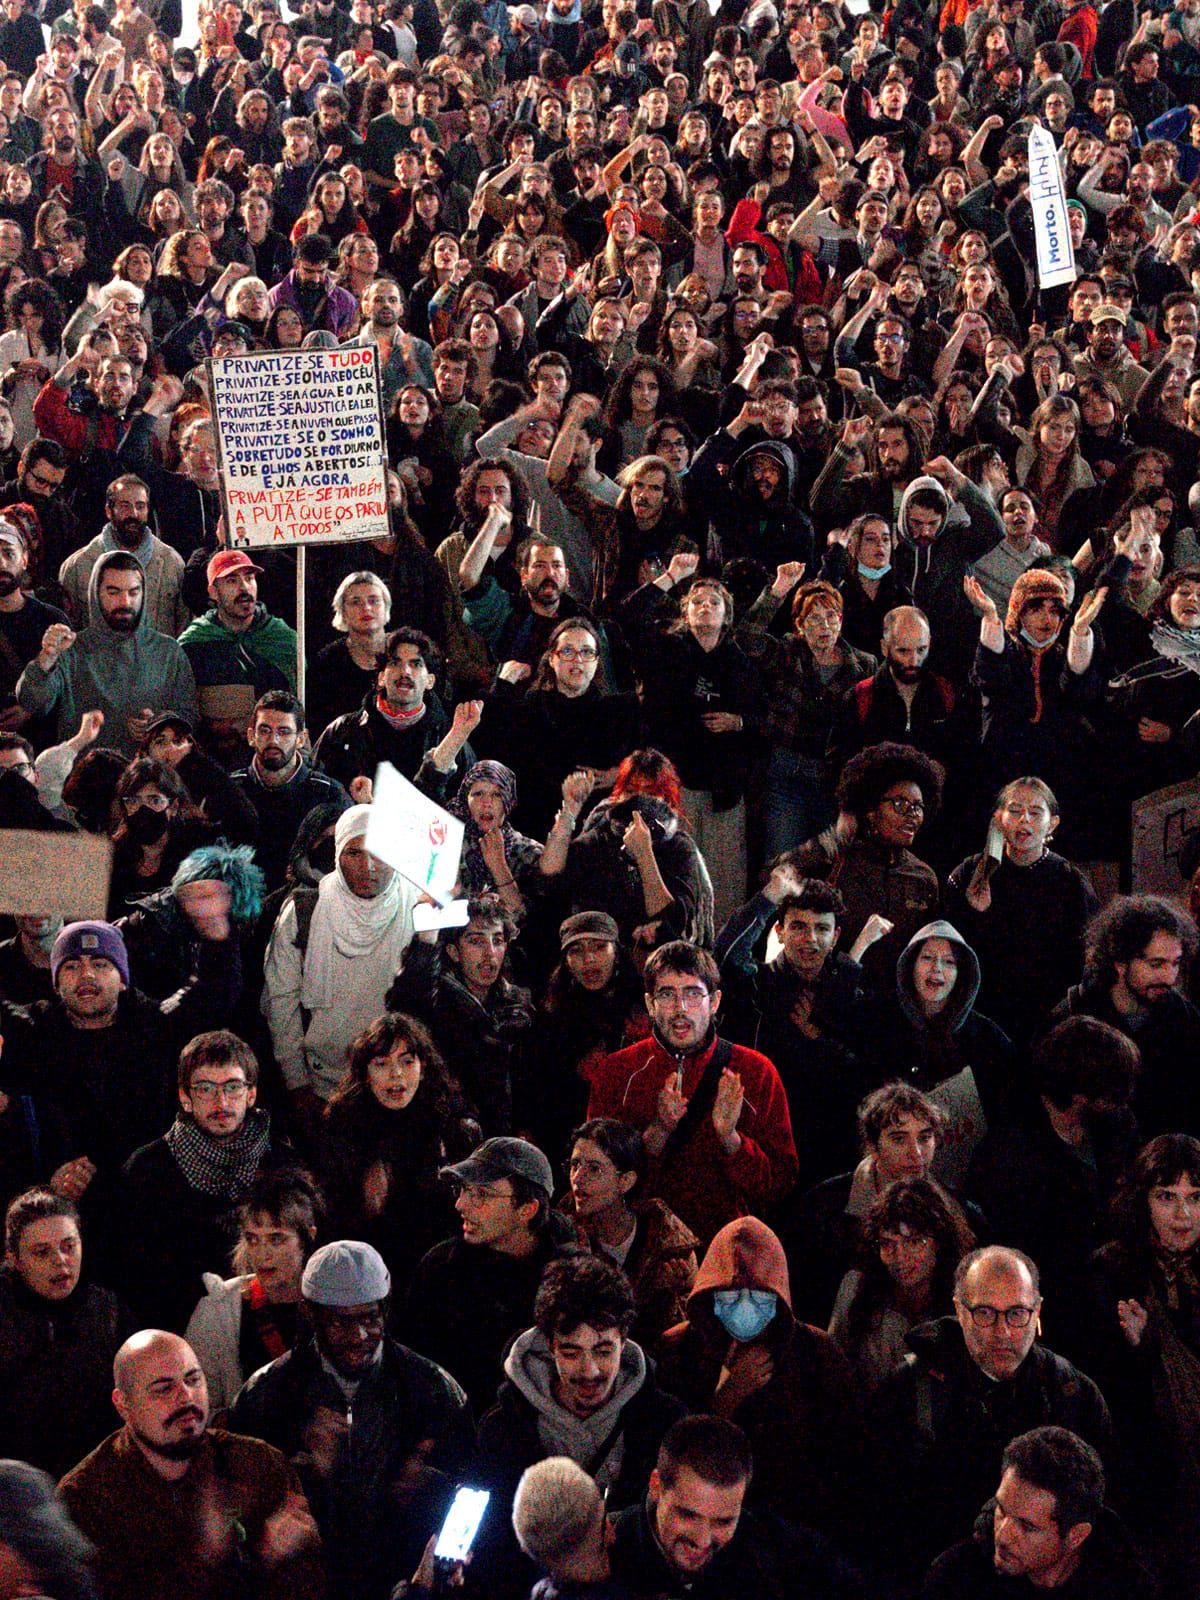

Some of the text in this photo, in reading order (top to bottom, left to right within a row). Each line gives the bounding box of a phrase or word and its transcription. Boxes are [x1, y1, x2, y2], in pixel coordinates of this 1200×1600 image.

[1045, 204, 1060, 263] Morto.
[216, 372, 300, 390] PRIVATIZE-SE
[302, 371, 312, 384] O
[312, 369, 339, 384] MAR
[339, 370, 346, 381] E
[346, 369, 353, 381] O
[216, 391, 292, 404] PRIVATIZE-SE
[293, 390, 300, 399] A
[337, 386, 344, 397] E
[345, 385, 354, 396] O
[219, 402, 294, 418] PRIVATIZE-SE
[220, 419, 289, 434] PRIVATIZE-SE
[291, 419, 299, 429] A
[335, 415, 354, 427] QUE
[225, 431, 314, 448] PRIVATIZE-SE
[317, 429, 327, 443] O
[226, 447, 302, 463] SOBRETUDO
[303, 445, 319, 459] SE
[320, 444, 343, 457] FOR
[229, 464, 237, 477] E
[240, 464, 258, 477] DE
[261, 462, 301, 476] OLHOS
[228, 487, 332, 504] PRIVATIZE-SE
[236, 509, 246, 524] A
[252, 503, 297, 525] PUTA
[299, 504, 333, 520] QUE
[335, 505, 354, 520] OS
[273, 525, 285, 541] A
